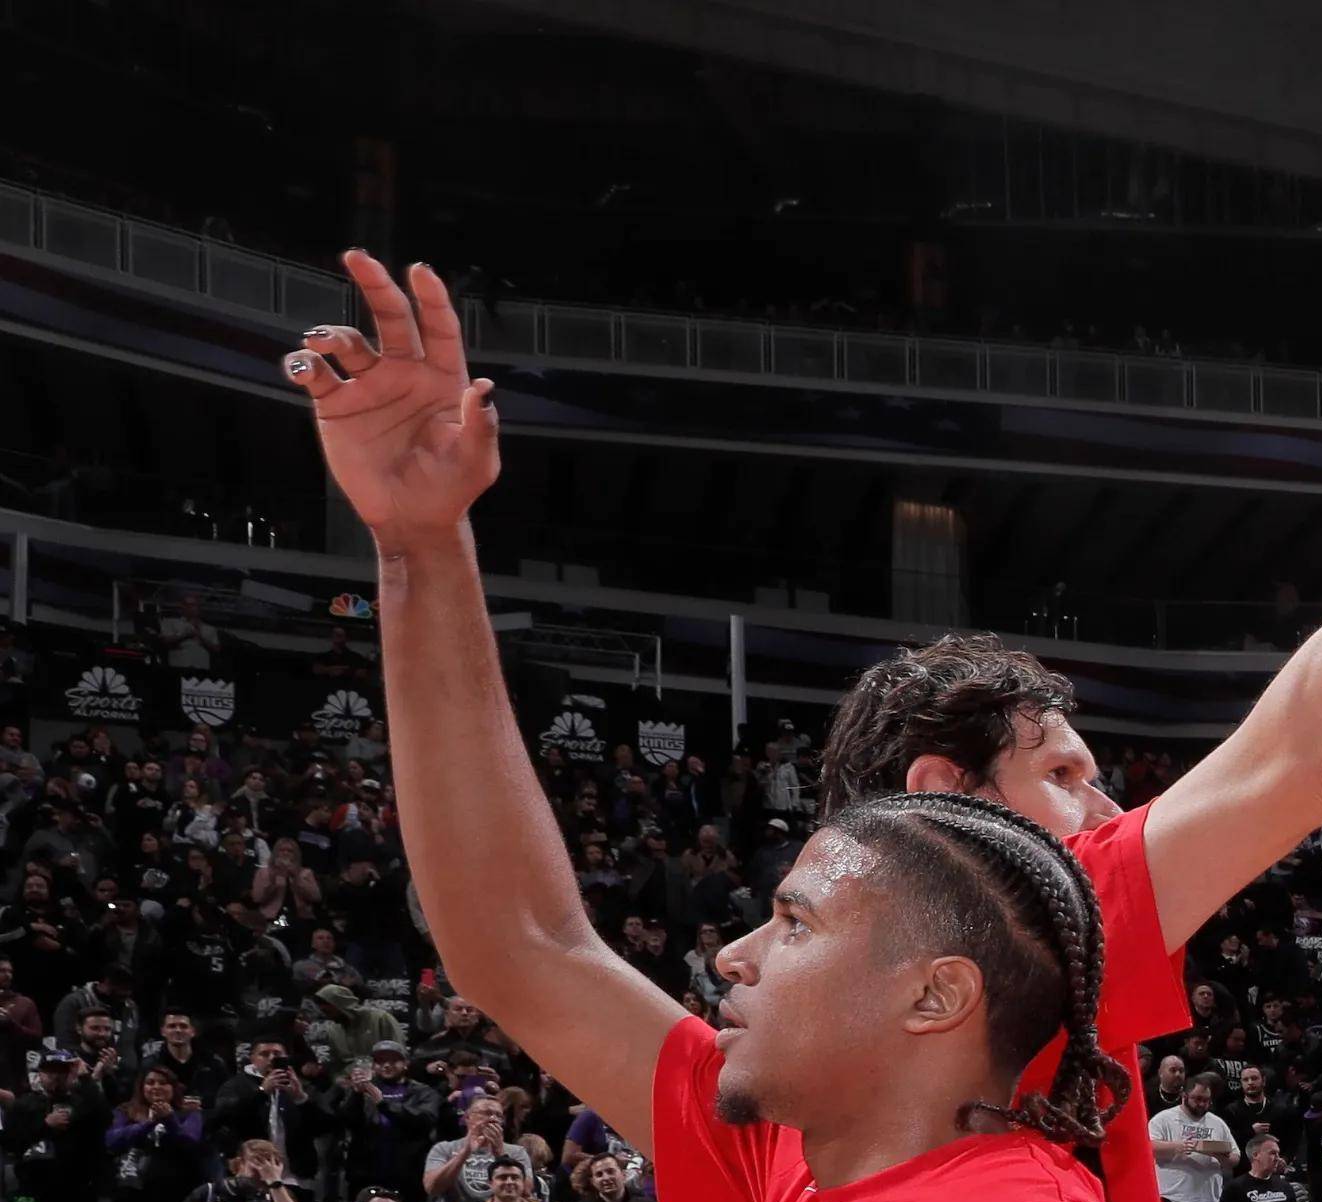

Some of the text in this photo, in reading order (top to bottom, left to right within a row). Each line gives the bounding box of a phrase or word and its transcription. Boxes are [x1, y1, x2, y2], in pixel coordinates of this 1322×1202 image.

[181, 694, 234, 708] KINGS
[71, 708, 140, 721] ALIFORNIA
[639, 736, 685, 750] KINGS
